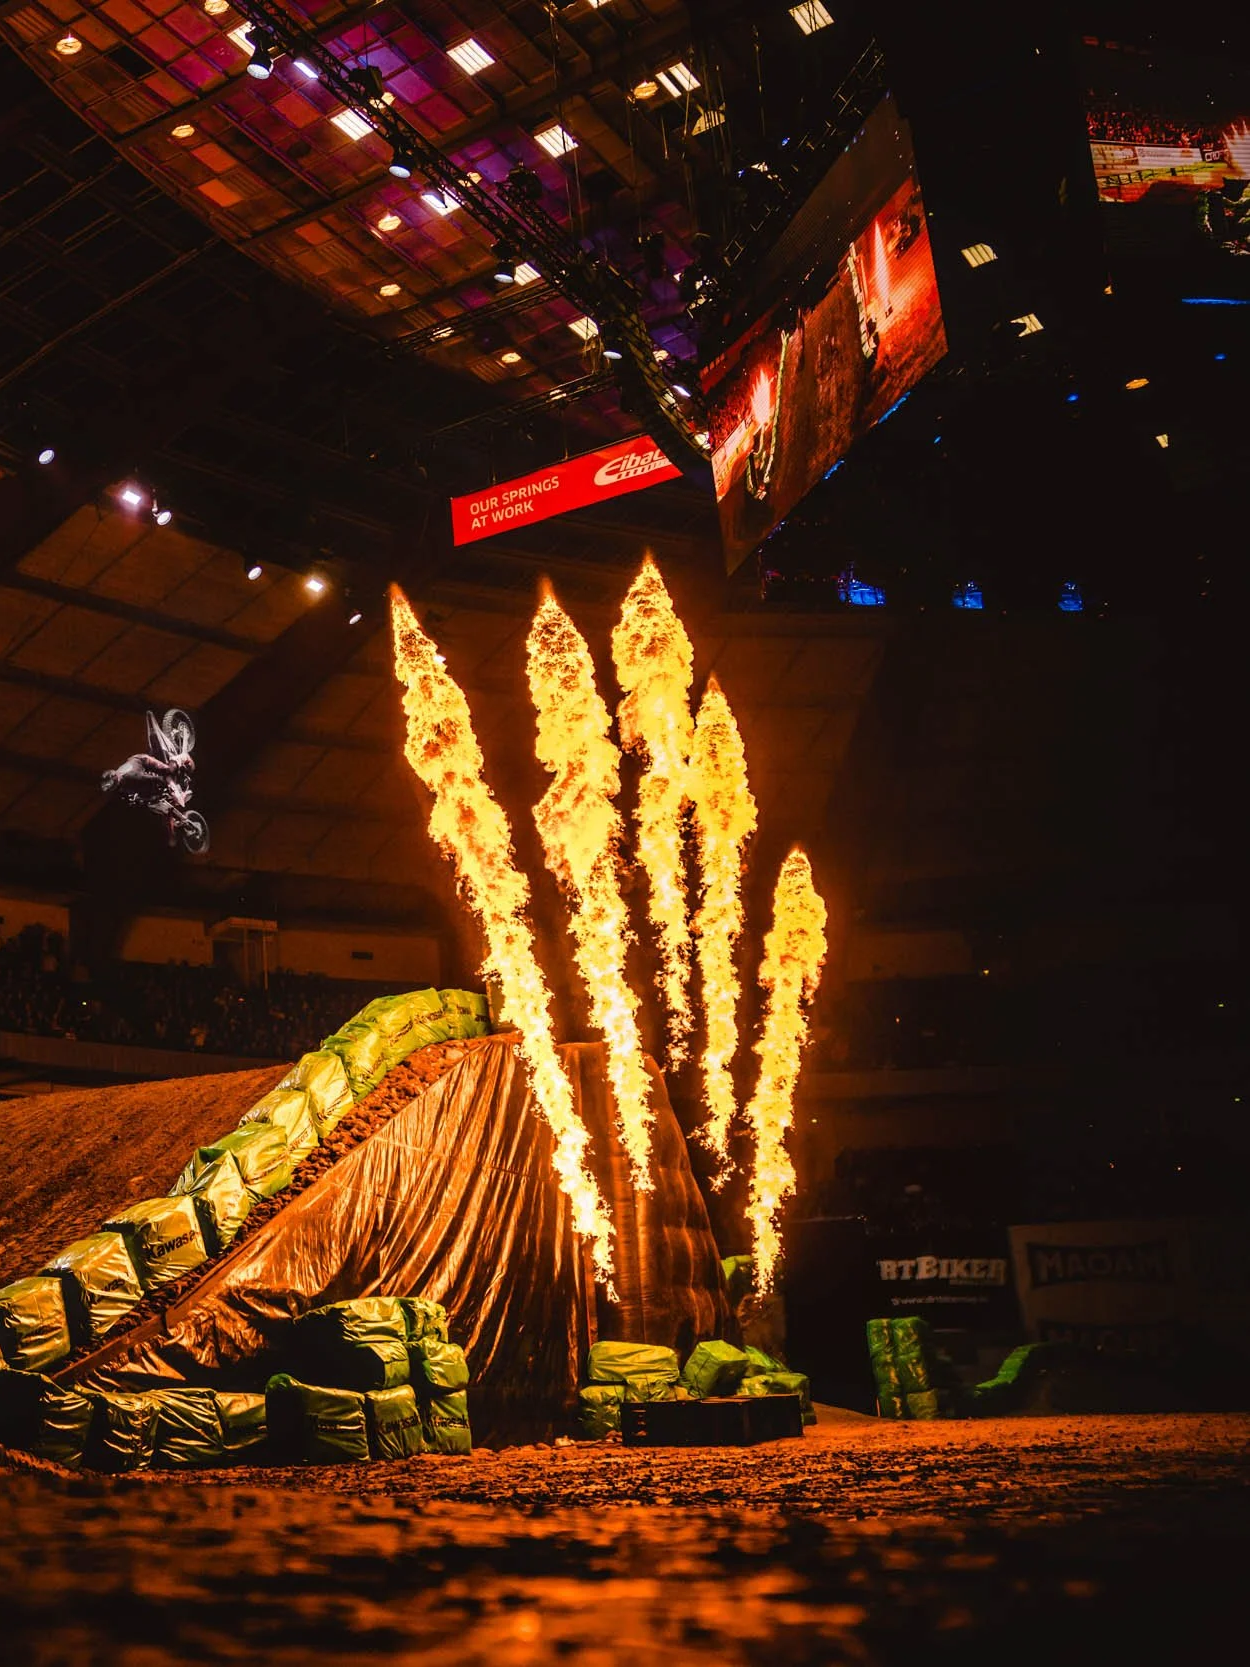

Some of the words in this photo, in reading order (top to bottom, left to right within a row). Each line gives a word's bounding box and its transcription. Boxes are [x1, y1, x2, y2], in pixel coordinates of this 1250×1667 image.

[594, 449, 667, 485] Eibac
[470, 496, 499, 515] OUR
[501, 476, 559, 505] SPRINGS
[471, 514, 487, 530] AT
[491, 500, 534, 523] WORK
[146, 1230, 200, 1259] Kawasa
[876, 1254, 1007, 1282] RTBIKER
